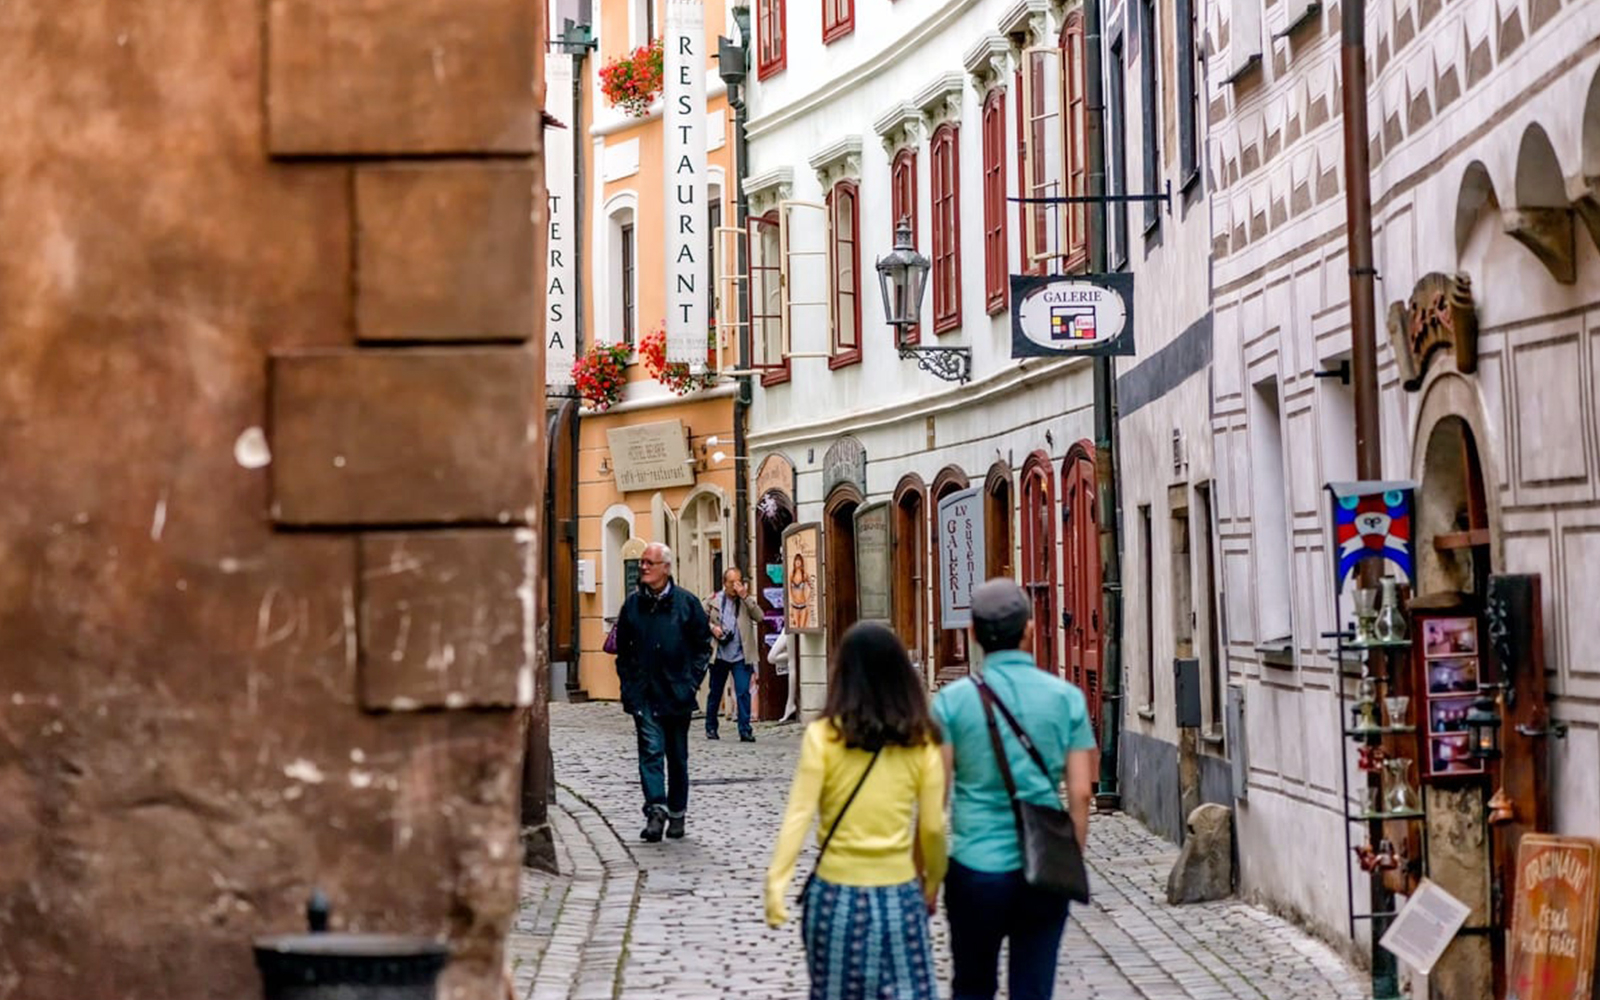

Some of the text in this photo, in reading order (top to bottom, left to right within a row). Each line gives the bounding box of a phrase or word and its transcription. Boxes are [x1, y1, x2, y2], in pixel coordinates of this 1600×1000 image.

[676, 36, 695, 323] RESTAURANT
[548, 195, 564, 349] TERASA
[1043, 290, 1102, 303] GALERIE
